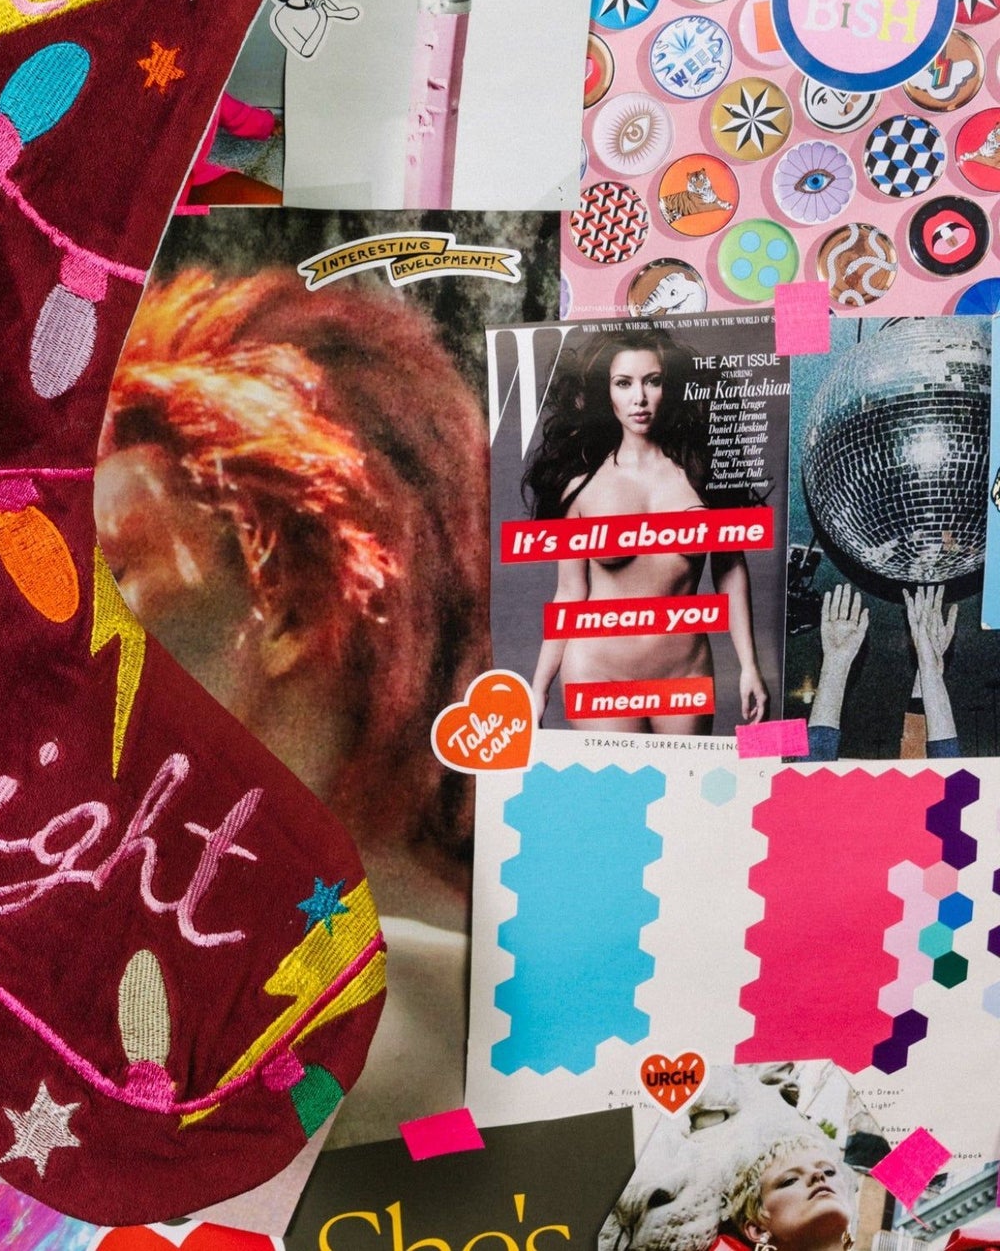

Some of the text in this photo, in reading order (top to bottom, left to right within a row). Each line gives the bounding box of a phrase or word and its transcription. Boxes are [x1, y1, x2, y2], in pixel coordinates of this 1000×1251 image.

[670, 43, 723, 88] WEED
[322, 241, 431, 273] INTERESTING
[394, 255, 496, 276] DEVELOPMENT!
[677, 320, 692, 328] AND
[693, 318, 709, 327] WHY
[711, 317, 719, 326] IN
[720, 317, 735, 326] THE
[736, 315, 759, 325] WORLD
[761, 315, 770, 324] OF
[692, 353, 780, 369] THE ART ISSUE
[721, 370, 753, 379] STARRING
[485, 325, 578, 461] W
[683, 378, 790, 401] Kim Kardashian
[710, 399, 766, 411] Barbara Kruger
[738, 411, 766, 421] Herman
[709, 423, 733, 434] Daniel
[707, 435, 733, 447] Johnny
[743, 445, 763, 455] Teller
[711, 459, 729, 469] Ryan
[512, 522, 765, 555] It's all about me
[556, 607, 719, 631] I mean you
[574, 691, 707, 712] I mean me
[447, 711, 505, 758] Take
[479, 717, 527, 763] care
[584, 738, 639, 749] STRANGE,
[646, 1070, 699, 1087] URGH.
